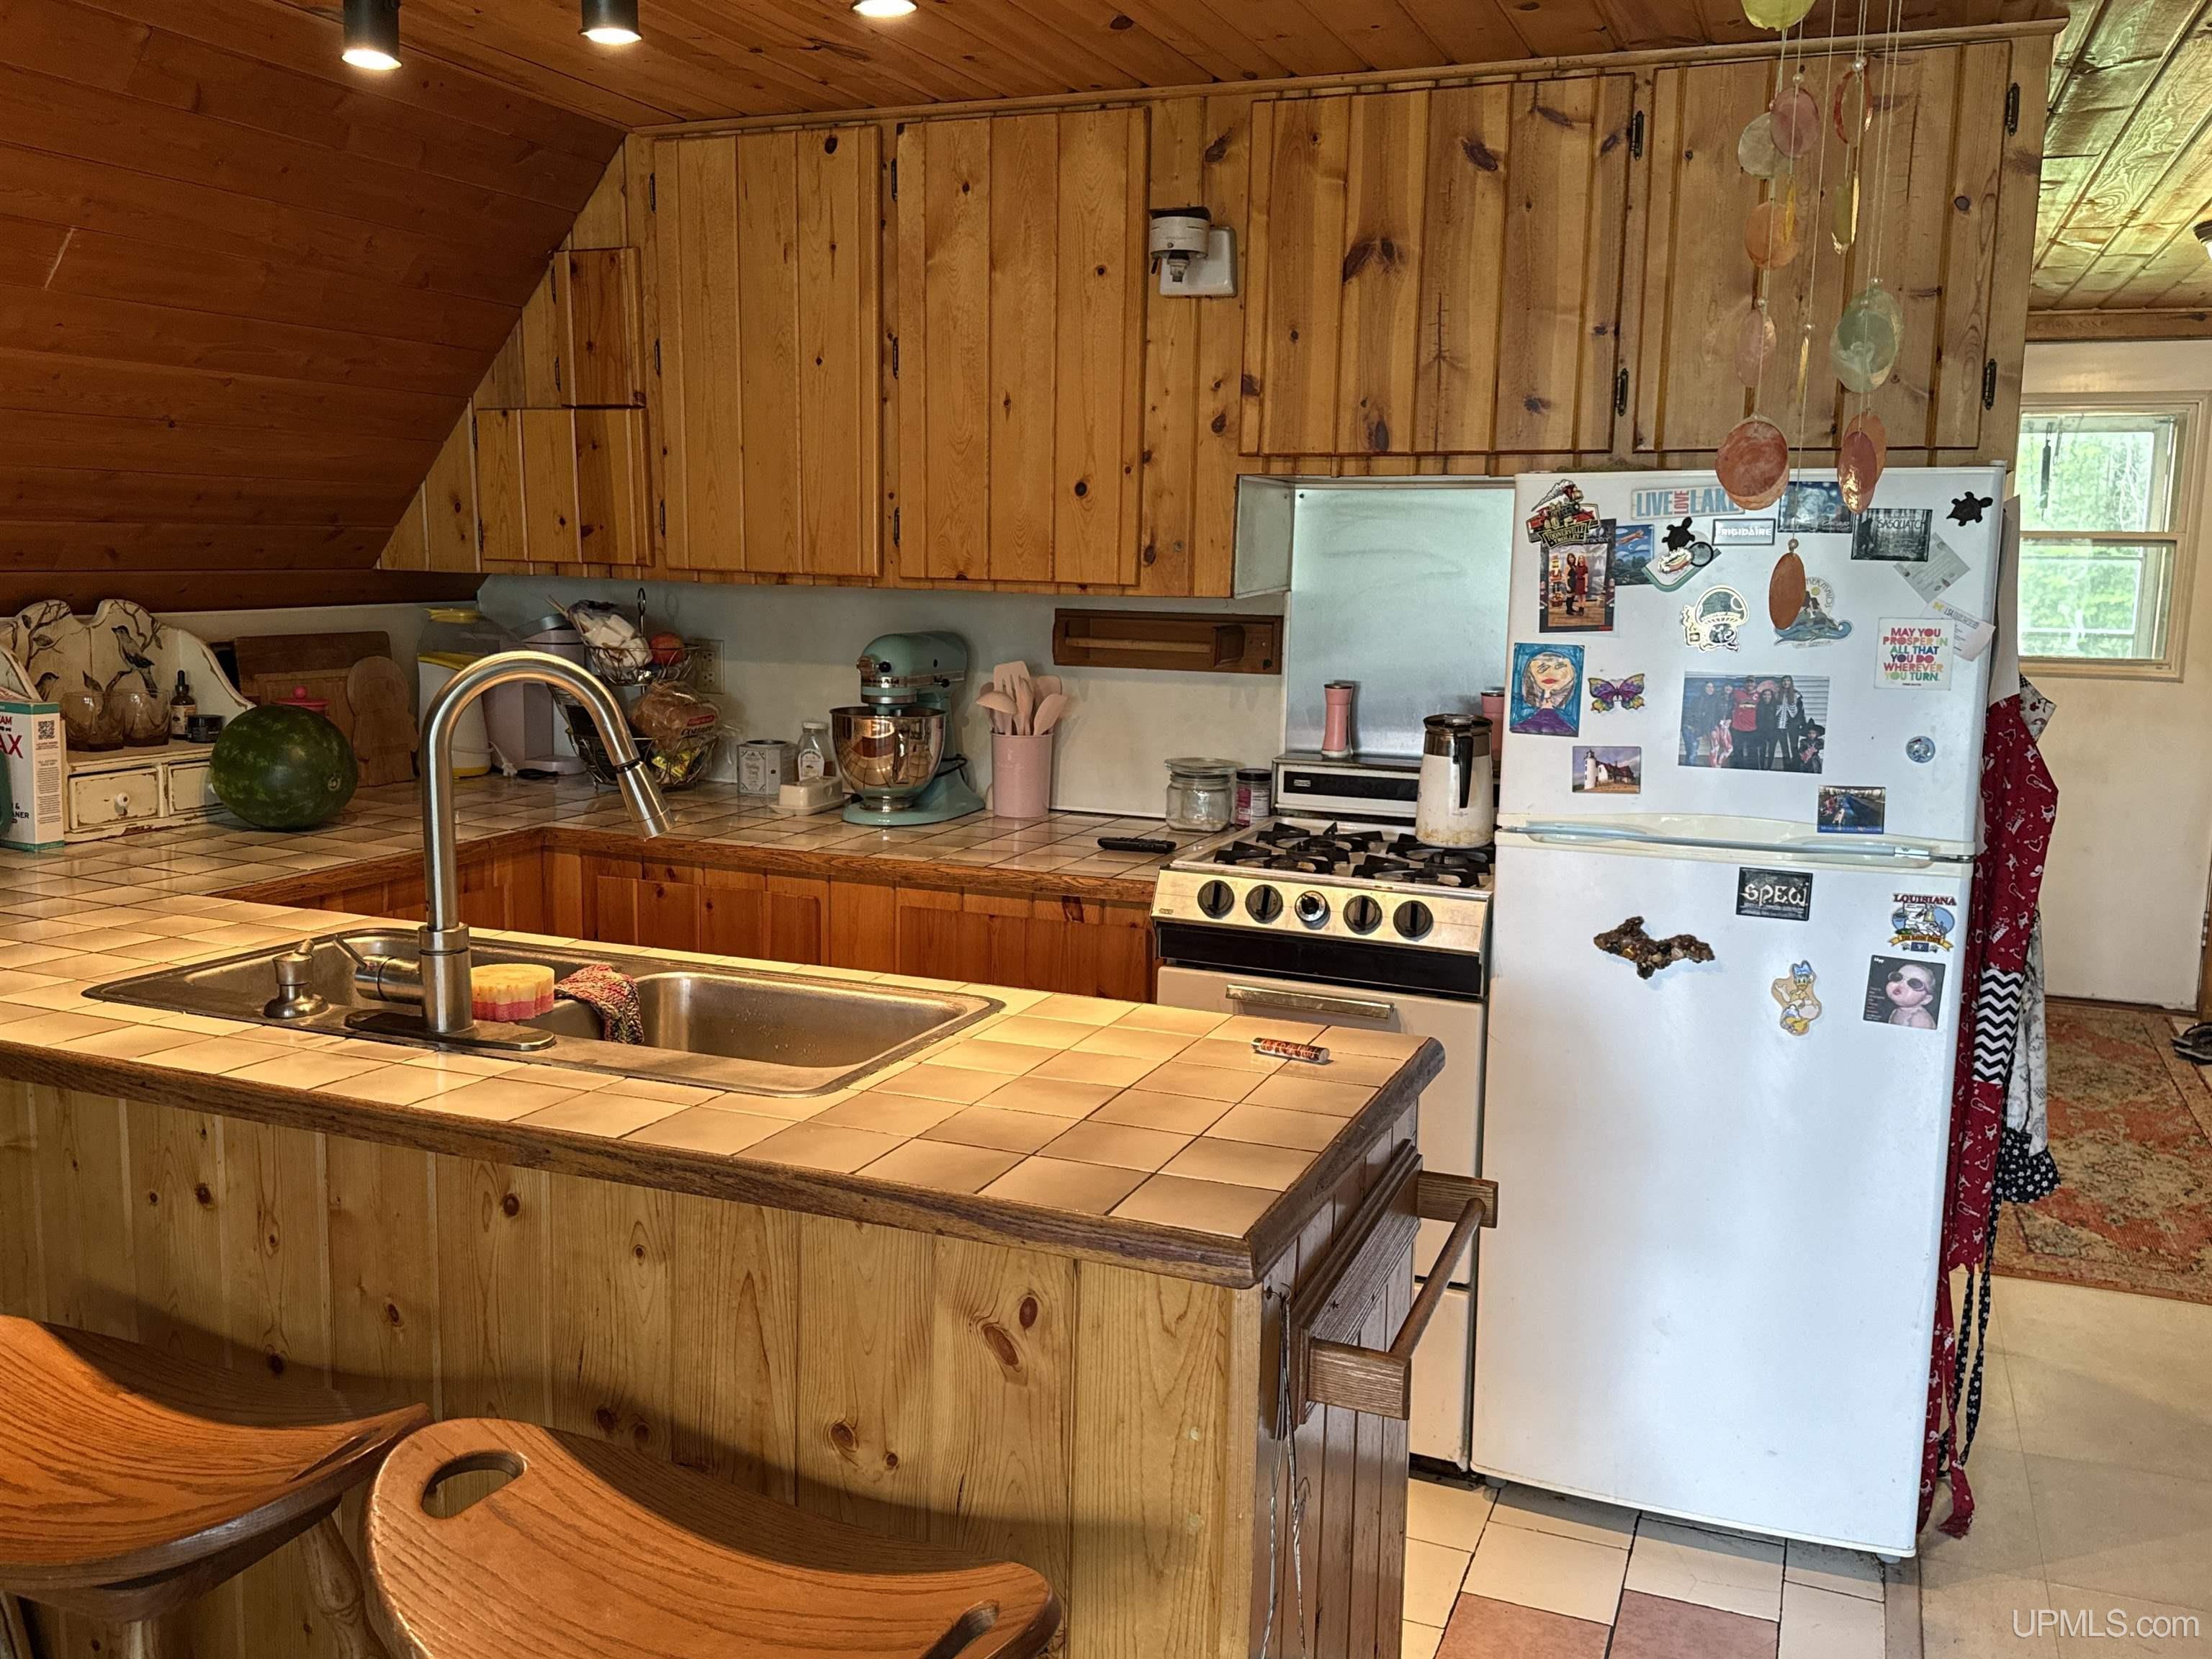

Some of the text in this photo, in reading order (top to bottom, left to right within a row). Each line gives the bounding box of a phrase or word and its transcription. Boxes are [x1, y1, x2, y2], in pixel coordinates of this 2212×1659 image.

[1637, 491, 1673, 516] LIVE
[1674, 490, 1689, 514] LOVE
[1877, 518, 1925, 530] SASQUATCH
[1717, 526, 1773, 536] FRIGIDAIRE
[1891, 628, 1941, 637] MAY YOU
[1883, 637, 1948, 646] PROSPER IN
[1912, 646, 1939, 655] THAT
[1891, 654, 1913, 662] YOU
[1884, 662, 1943, 673] WHEREVER
[1910, 673, 1940, 681] TURN.
[1893, 894, 1956, 906] LOUISIANA
